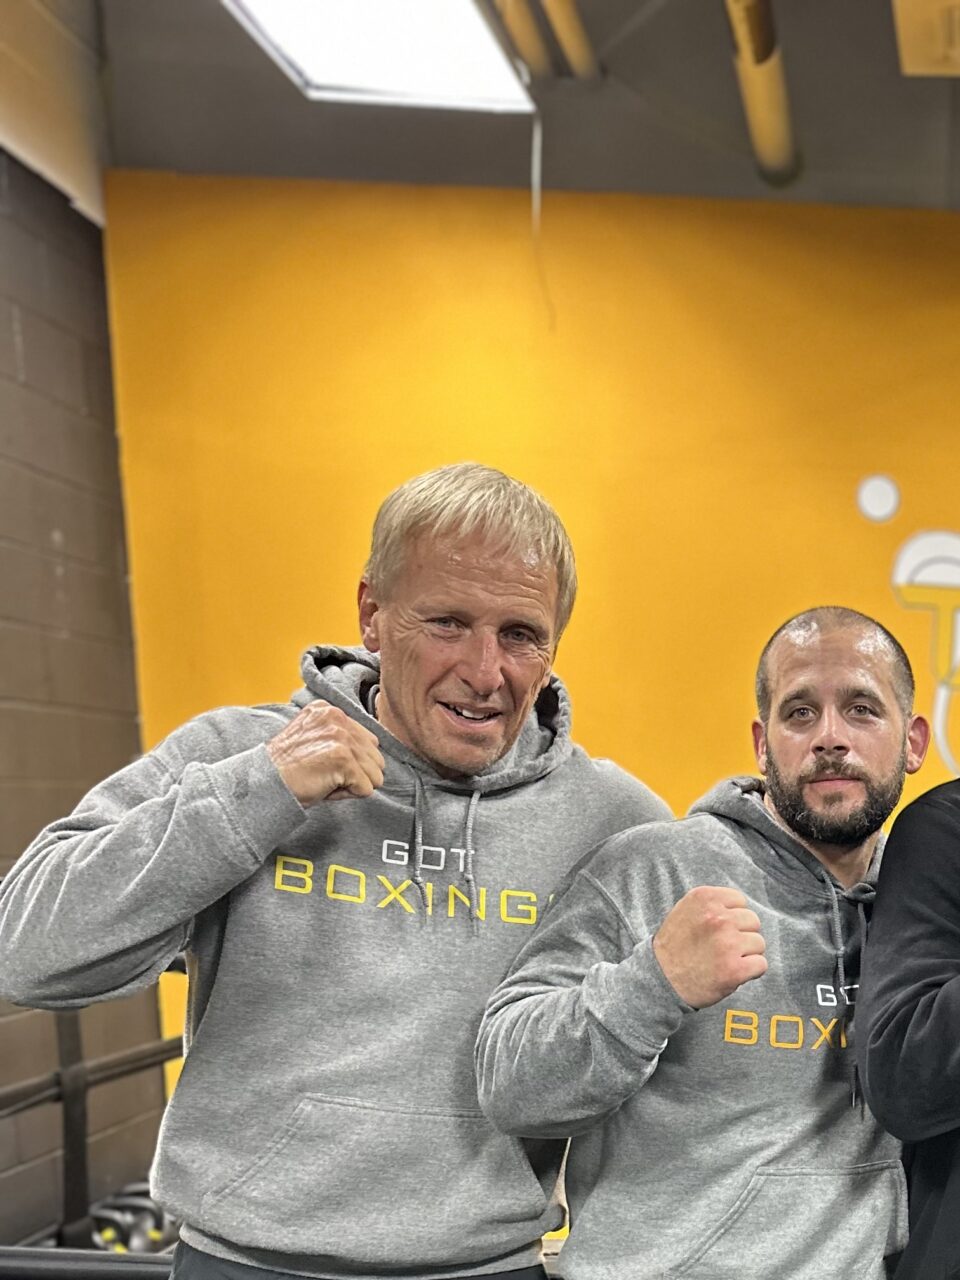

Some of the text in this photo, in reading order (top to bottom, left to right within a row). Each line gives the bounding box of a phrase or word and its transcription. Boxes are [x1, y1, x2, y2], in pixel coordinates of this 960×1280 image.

[381, 839, 475, 873] GOT
[274, 854, 554, 926] BOXING
[816, 983, 860, 1007] GO
[724, 1008, 848, 1051] BOXI
